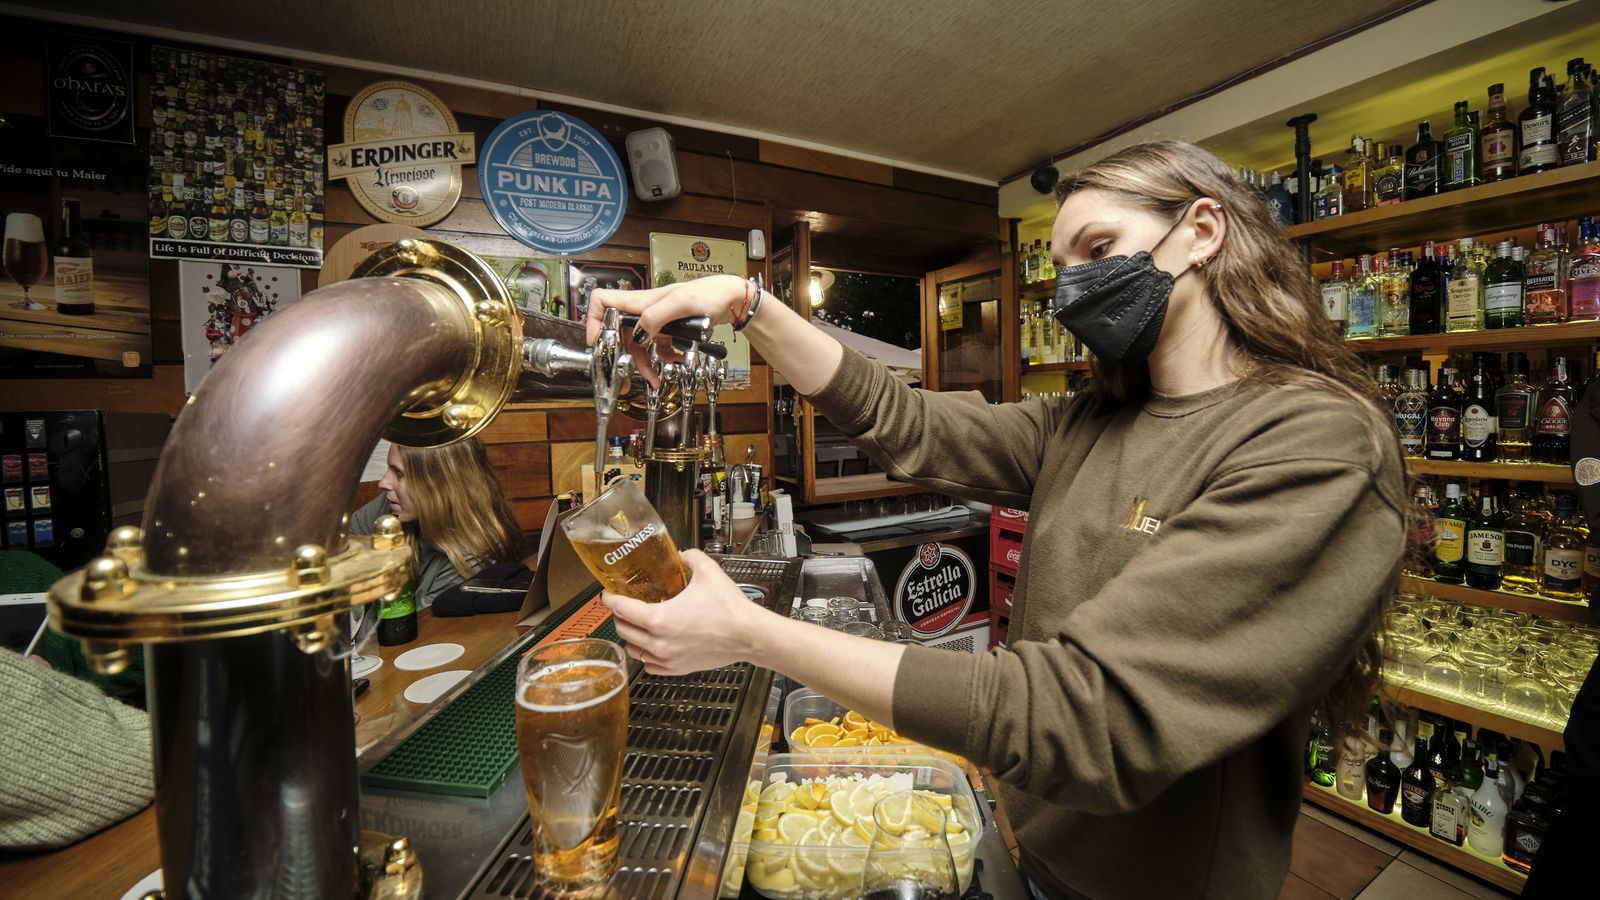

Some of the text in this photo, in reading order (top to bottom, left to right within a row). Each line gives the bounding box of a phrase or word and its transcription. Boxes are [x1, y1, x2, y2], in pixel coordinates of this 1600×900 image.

[350, 141, 458, 168] ERDINGER
[535, 153, 576, 168] BREWDOG
[25, 166, 53, 177] aquí
[56, 169, 69, 178] tu
[72, 169, 107, 180] Maier
[373, 166, 436, 188] Urweisse
[497, 170, 612, 199] PUNK IPA
[519, 197, 594, 213] POST MODERN CLASSIC
[155, 244, 320, 263] Life Is Full Of Difficult Decisions
[678, 261, 724, 273] PAULANER
[604, 523, 655, 565] GUINNESS
[1552, 560, 1577, 568] DYC
[907, 565, 961, 601] Estrella
[912, 584, 961, 617] Galicia
[1470, 799, 1494, 818] ALIBU
